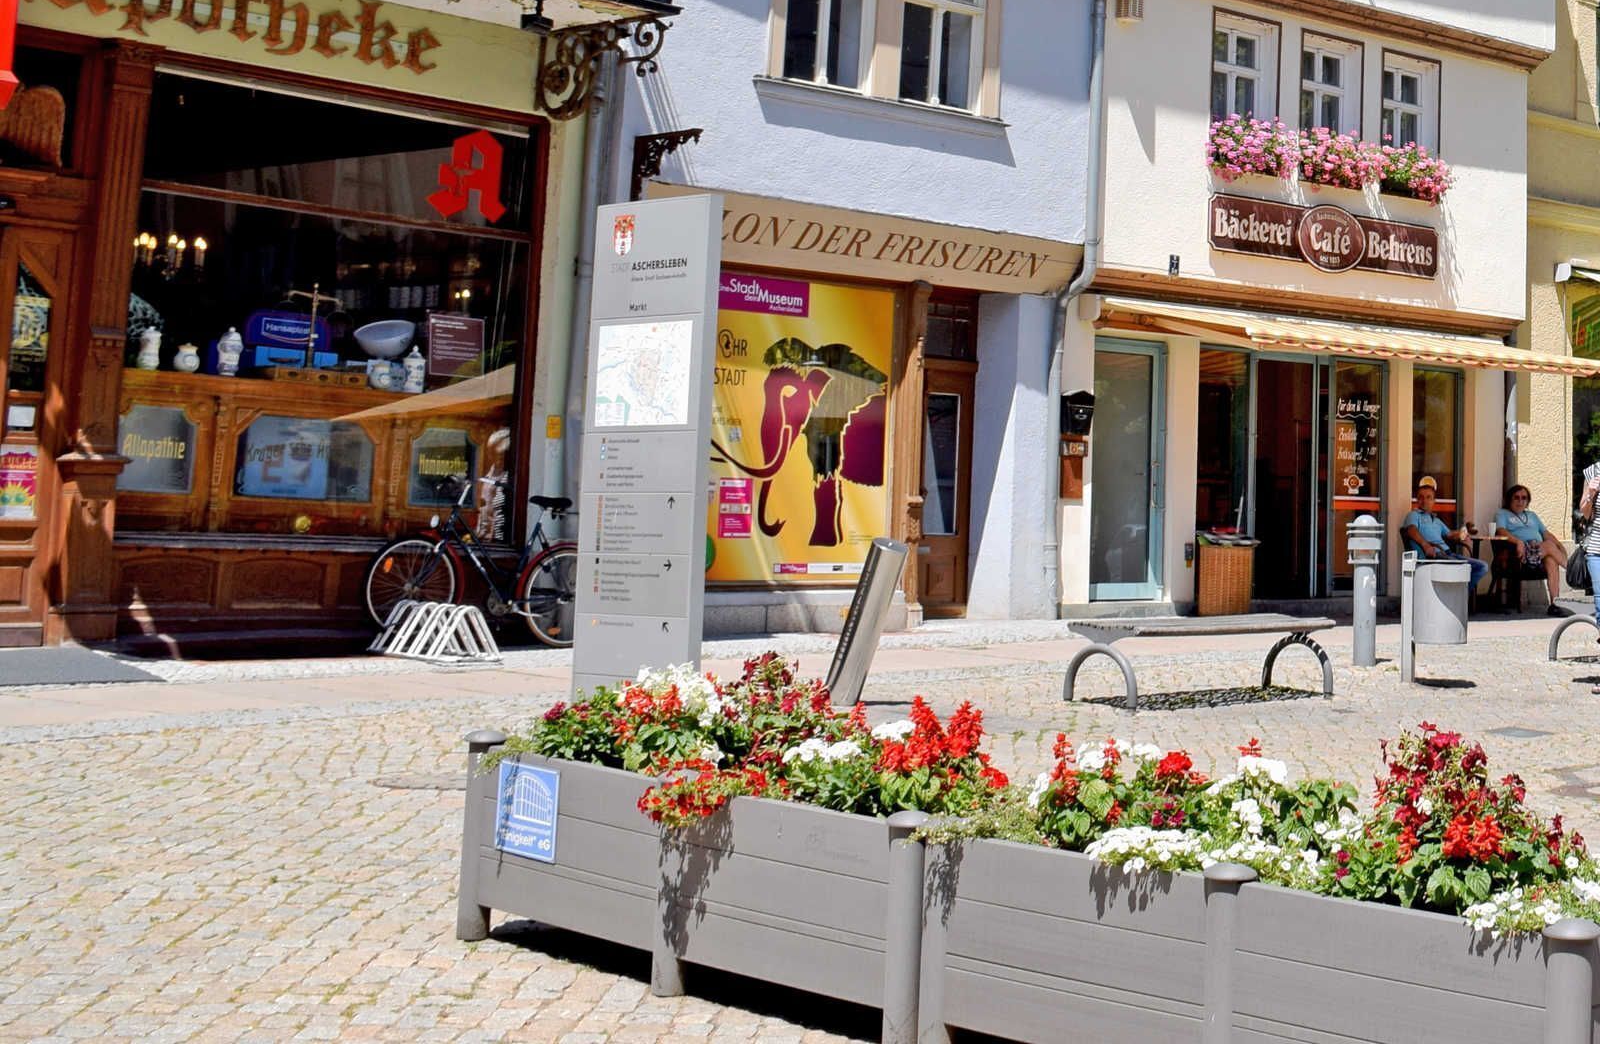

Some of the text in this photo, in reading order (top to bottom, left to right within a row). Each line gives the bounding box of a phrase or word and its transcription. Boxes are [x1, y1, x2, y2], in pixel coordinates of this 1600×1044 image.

[1214, 207, 1292, 247] Bäckerei
[1310, 223, 1351, 255] Café
[791, 221, 872, 257] DER
[876, 232, 1050, 279] FRISUREN
[1368, 231, 1433, 267] Behrens
[631, 257, 688, 271] ASCHERSLEBEN
[729, 278, 759, 295] Stadt
[757, 289, 803, 307] Museum
[629, 302, 648, 312] Markt
[122, 434, 186, 463] Allopathie
